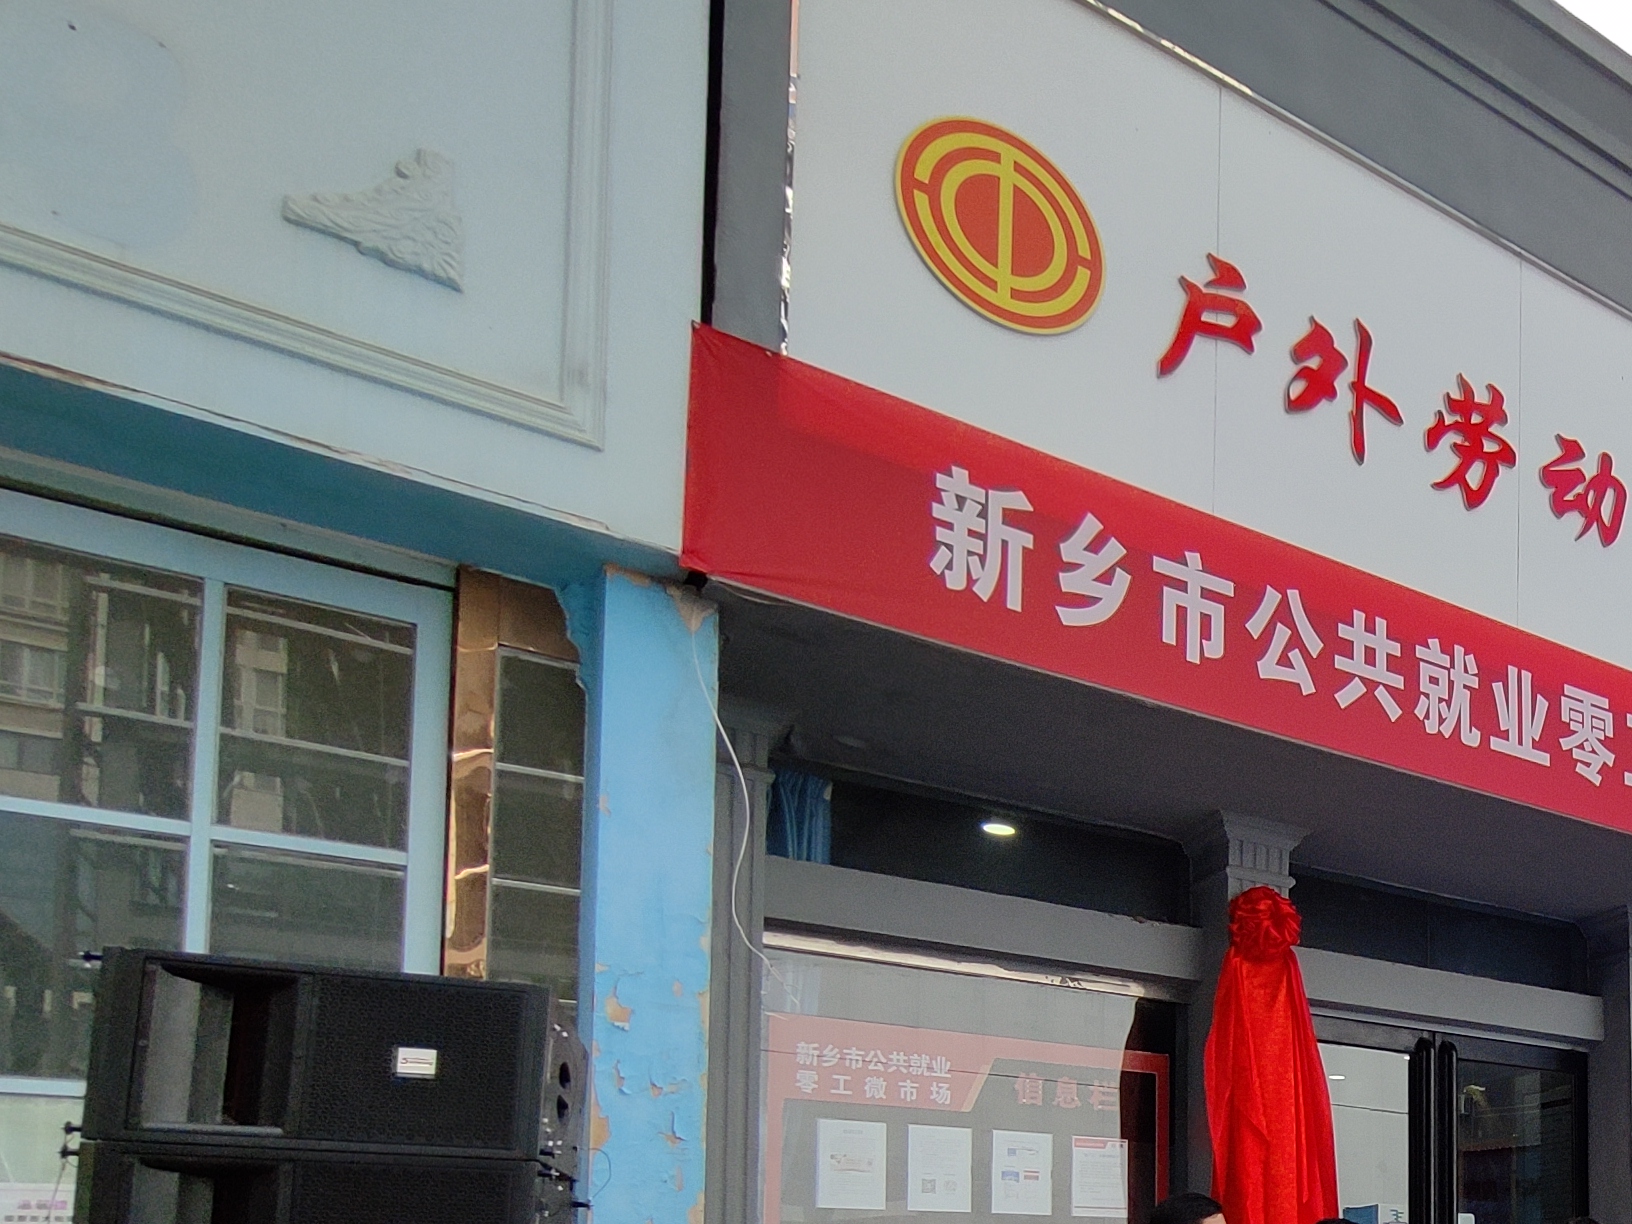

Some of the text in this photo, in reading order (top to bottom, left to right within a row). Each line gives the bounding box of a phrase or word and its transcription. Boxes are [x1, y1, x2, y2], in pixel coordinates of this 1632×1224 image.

[795, 1041, 952, 1078] 新乡市公共就业
[794, 1070, 952, 1106] 零工微市场
[1014, 1071, 1119, 1112] 信息栏
